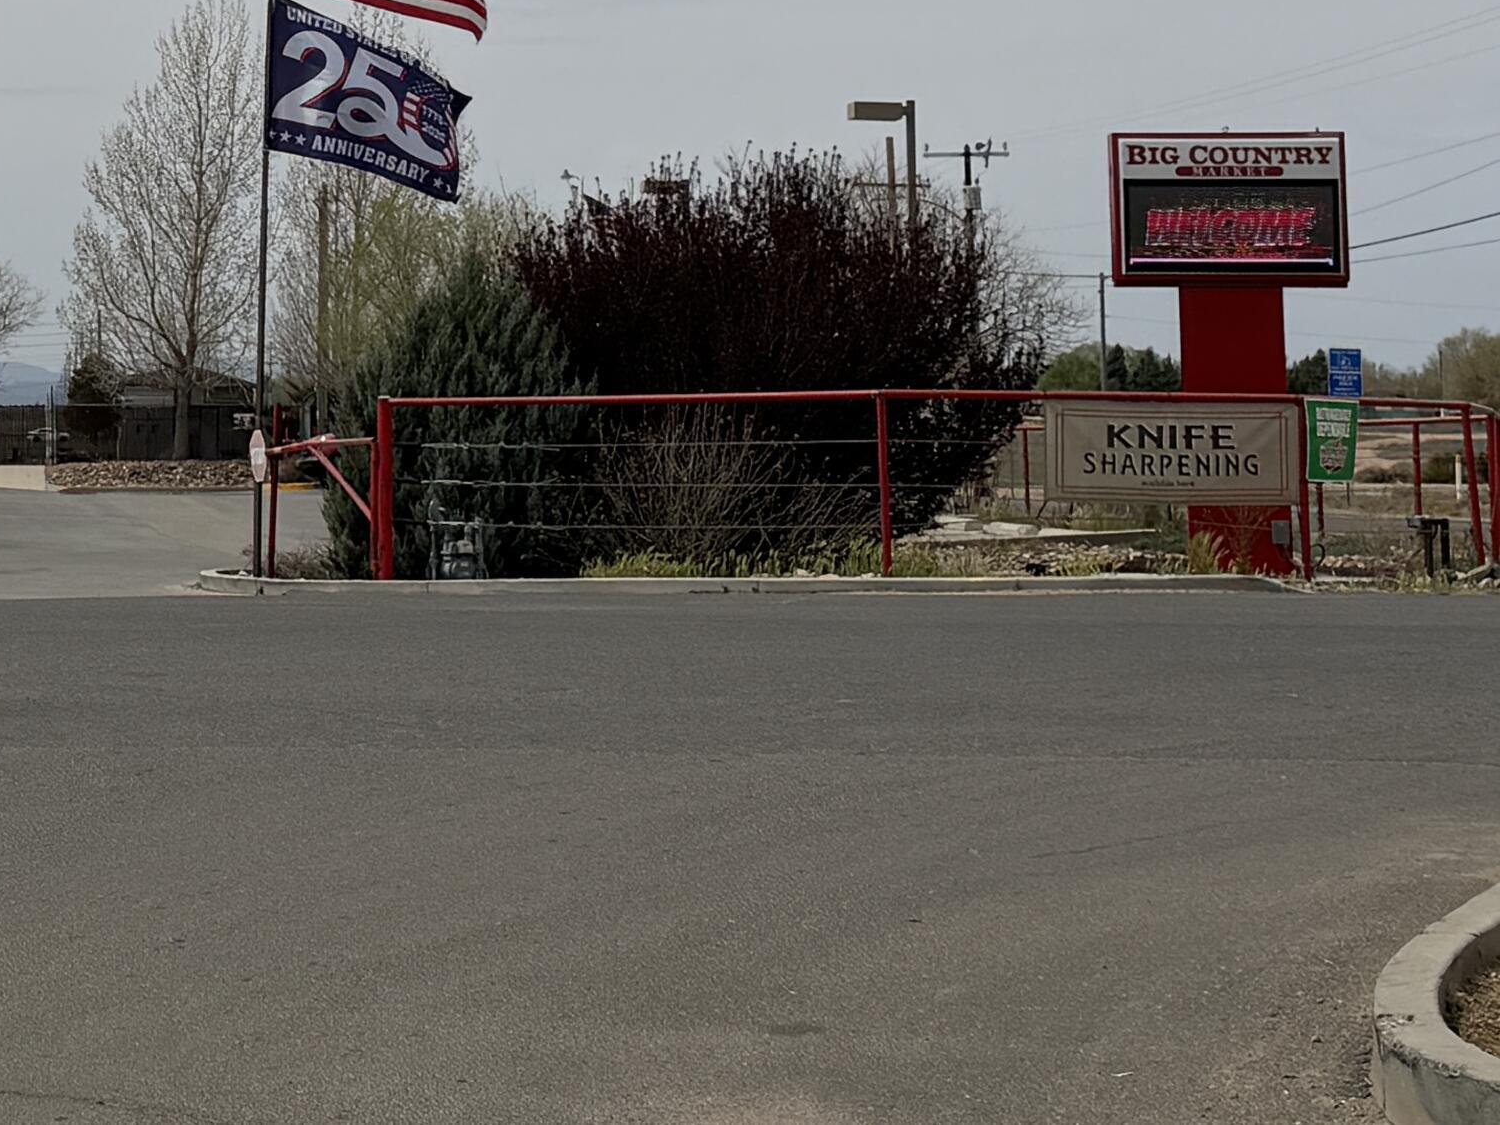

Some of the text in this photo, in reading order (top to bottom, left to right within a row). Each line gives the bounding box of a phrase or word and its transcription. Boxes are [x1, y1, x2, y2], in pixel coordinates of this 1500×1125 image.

[286, 5, 342, 34] UNITED
[311, 134, 430, 184] ANNIVERSARY
[1126, 145, 1333, 165] BIG COUNTRY
[1191, 166, 1267, 177] MARKET
[1106, 424, 1237, 450] KNIFE
[1083, 452, 1259, 476] SHARPENING
